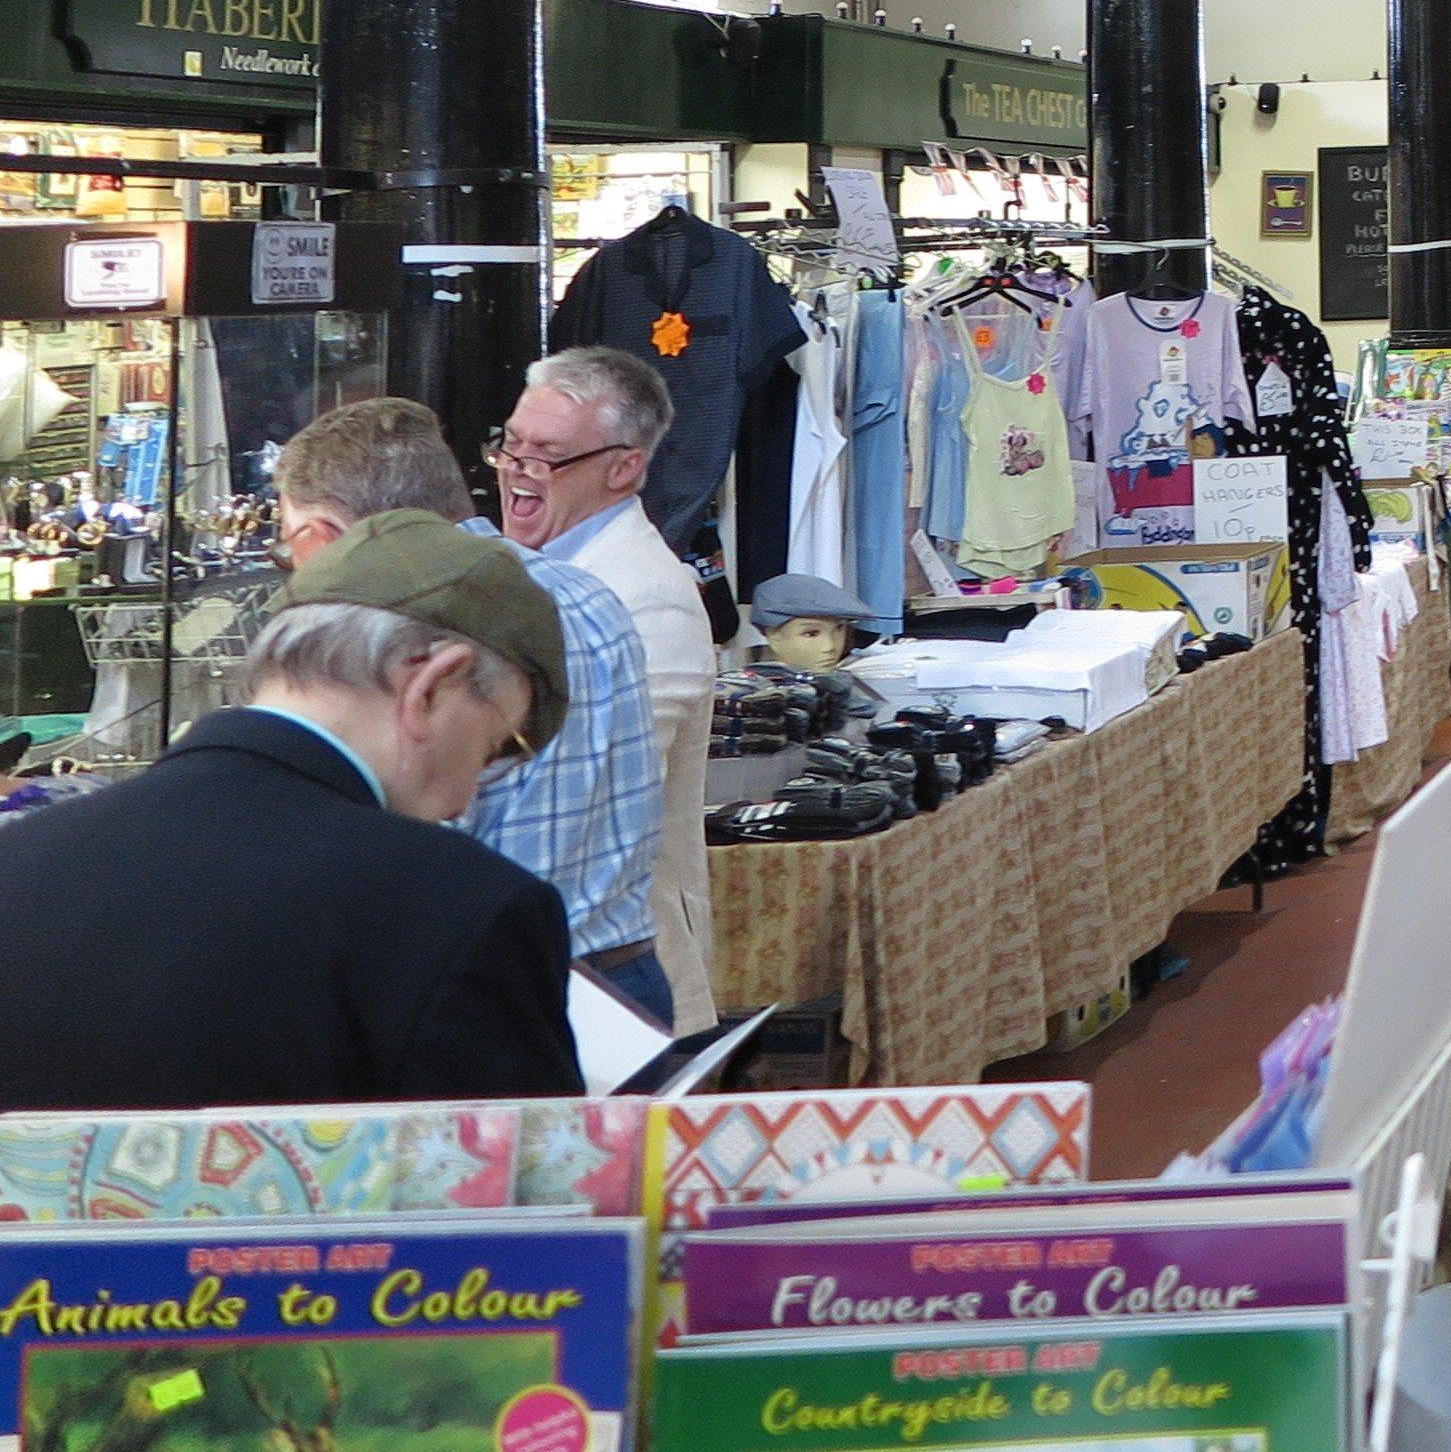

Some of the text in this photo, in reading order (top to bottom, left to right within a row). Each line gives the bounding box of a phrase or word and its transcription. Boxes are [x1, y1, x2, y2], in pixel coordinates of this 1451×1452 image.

[962, 82, 989, 118] The
[991, 83, 1022, 123] TEA
[1026, 89, 1074, 129] CHEST
[287, 237, 331, 257] SMILE
[269, 281, 320, 297] CAMERA
[308, 265, 329, 279] ON
[1207, 462, 1275, 481] COAT
[1200, 484, 1284, 503] HANGERS
[1213, 518, 1256, 542] 10p
[187, 1242, 393, 1277] POSTER ART
[910, 1237, 1115, 1273] POSTER ART
[0, 1268, 585, 1338] Animals to Colour
[771, 1265, 1258, 1327] Flowers to Colour
[893, 1340, 1101, 1381] POSTER ART
[761, 1366, 1233, 1439] Countryside to Colour
